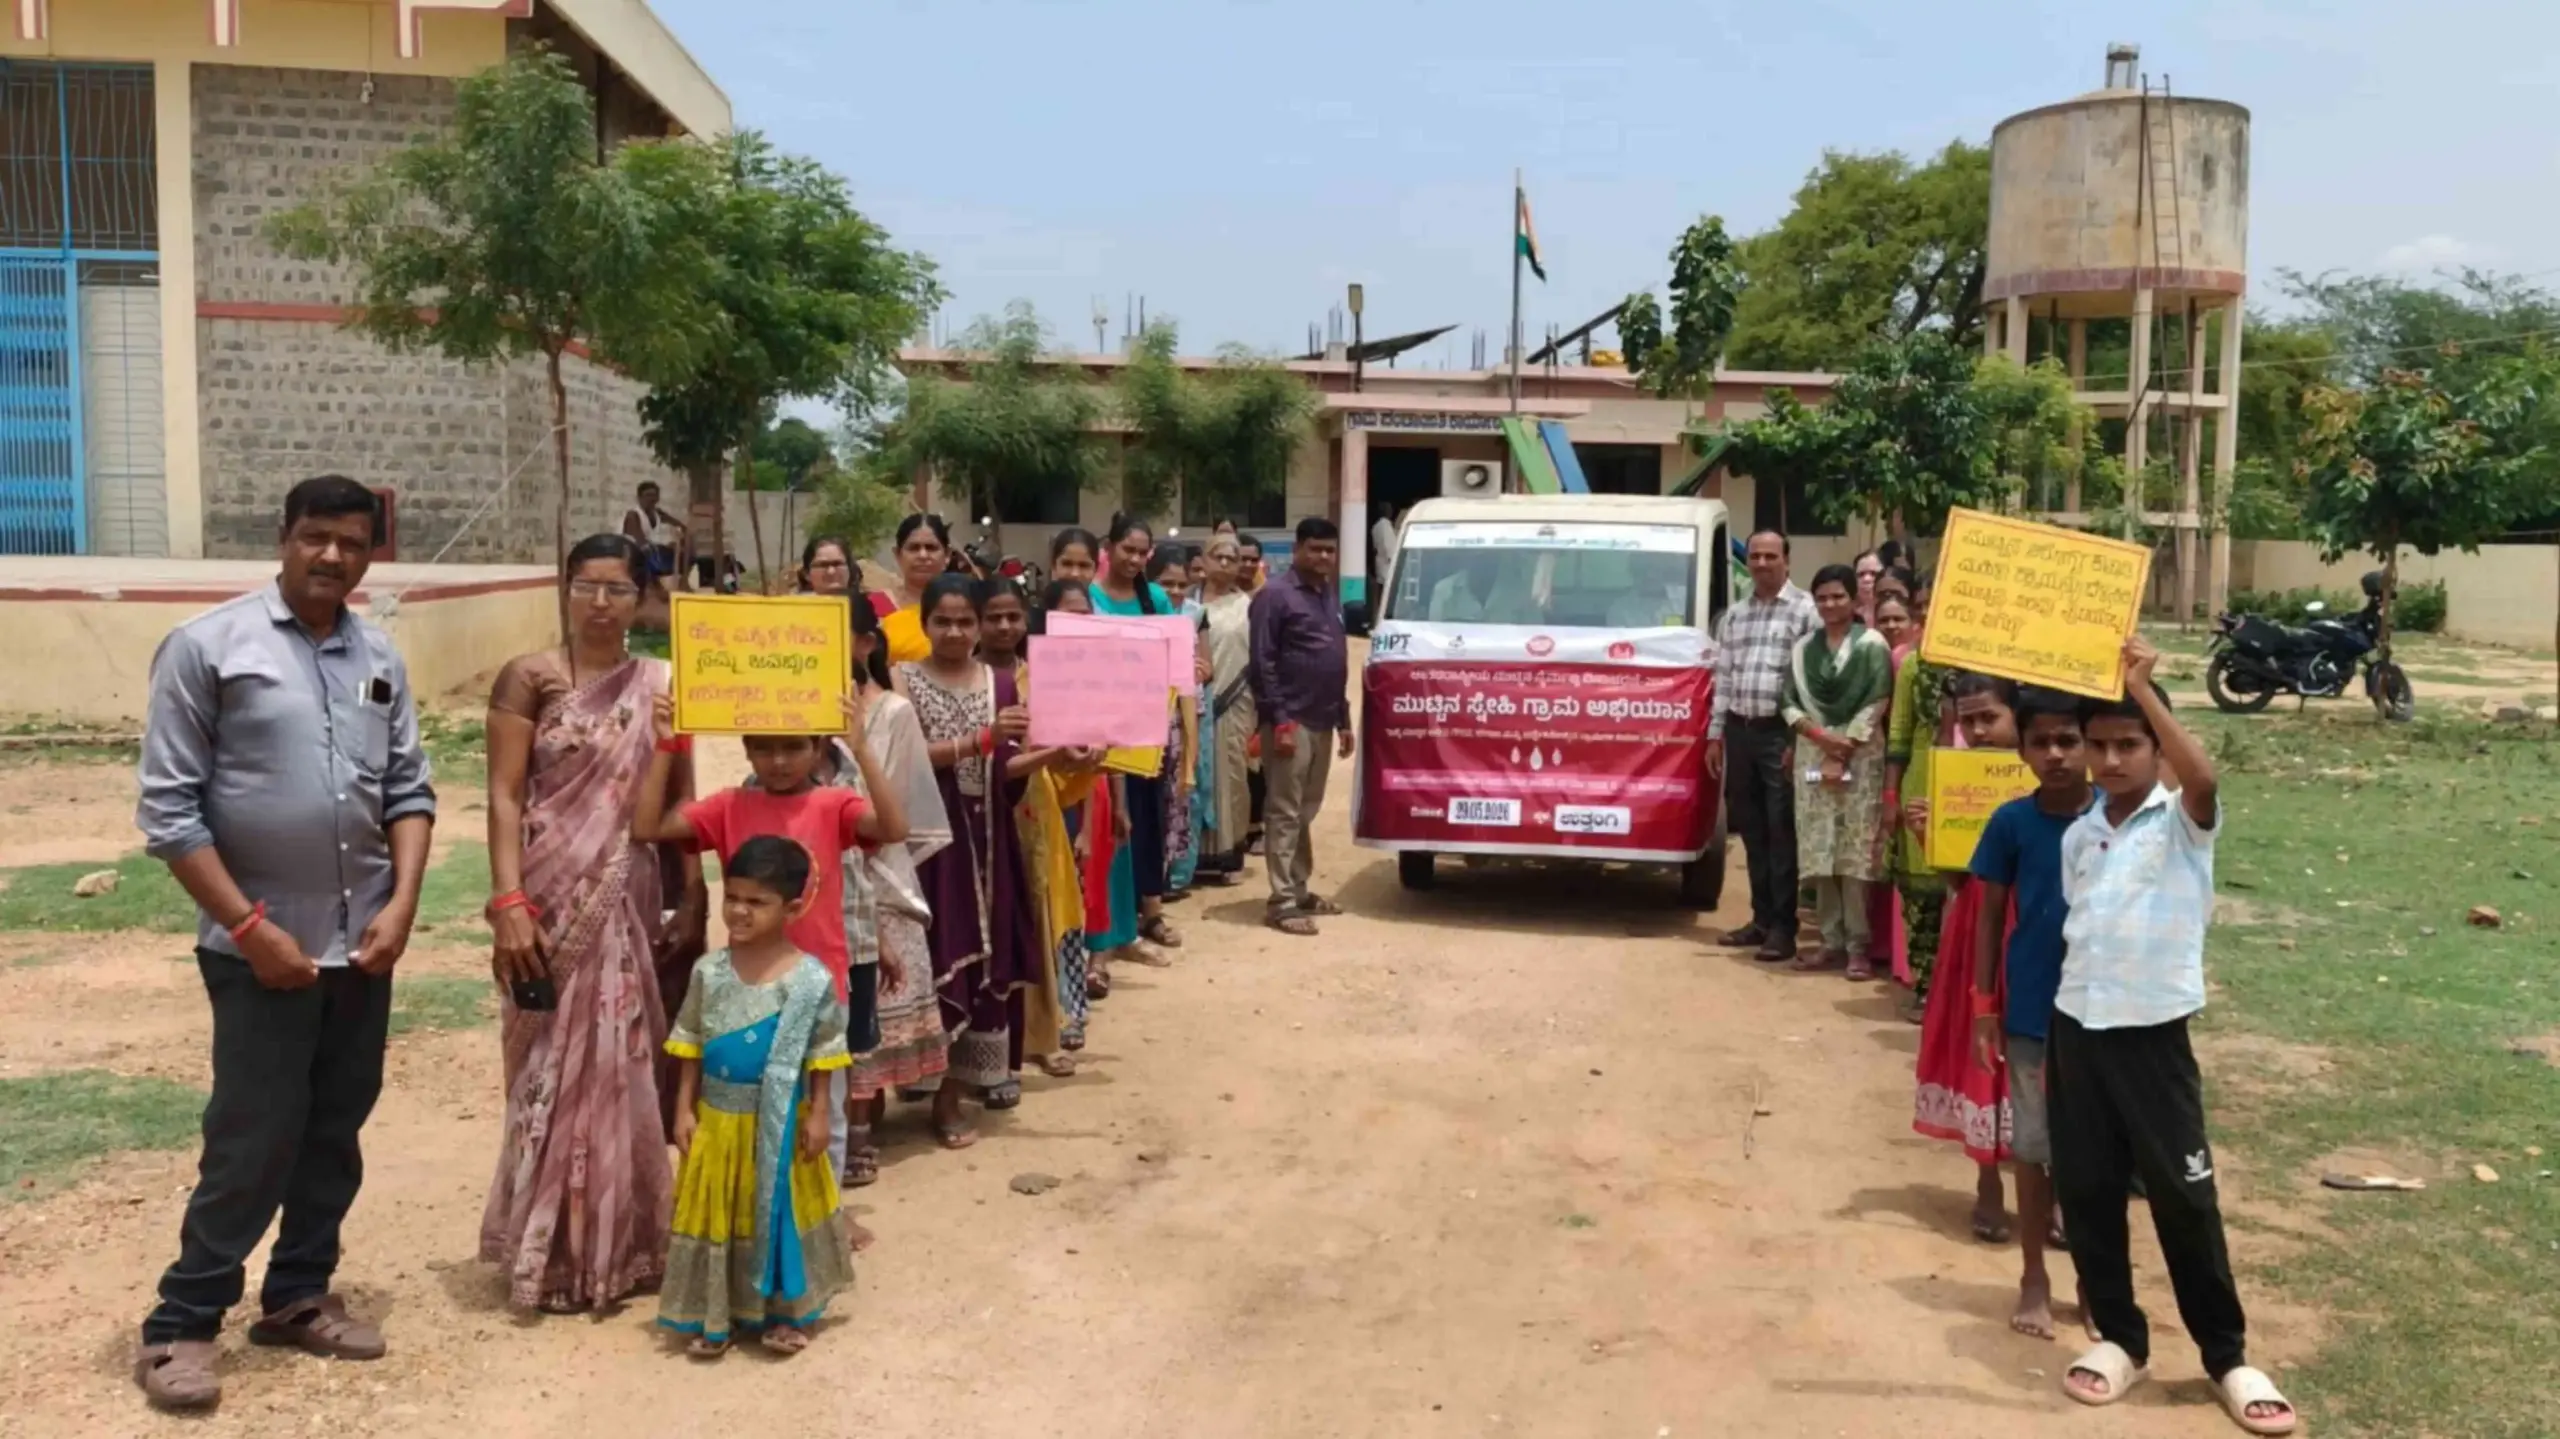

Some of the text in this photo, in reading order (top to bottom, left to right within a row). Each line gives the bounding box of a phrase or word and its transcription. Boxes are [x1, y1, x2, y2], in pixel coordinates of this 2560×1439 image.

[1392, 692, 1692, 723] ಮುಟ್ಟಿನ ಸ್ನೇಹಿ ಗ್ರಾಮ ಅಭಿಯಾನ
